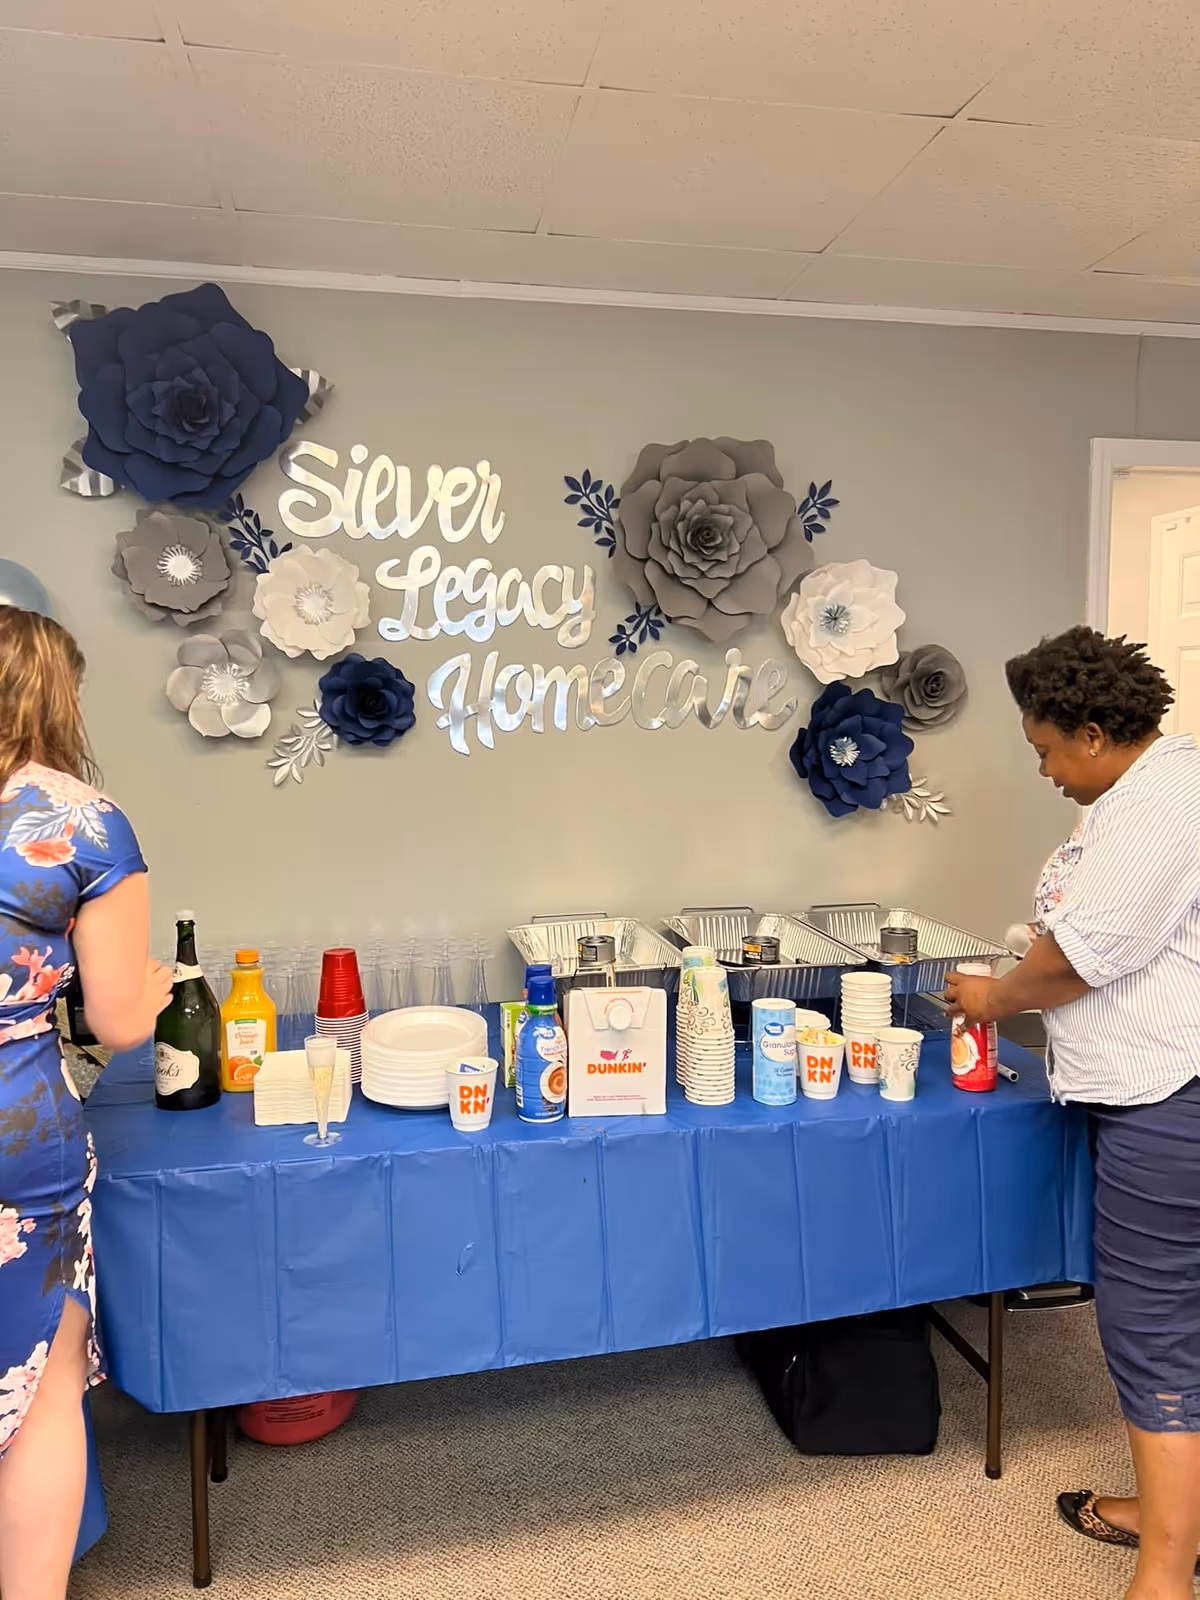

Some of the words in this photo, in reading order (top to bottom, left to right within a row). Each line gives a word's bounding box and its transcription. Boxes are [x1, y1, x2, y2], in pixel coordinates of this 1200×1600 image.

[278, 440, 506, 544] Silver
[375, 545, 596, 648] Legacy
[851, 1041, 876, 1056] DN
[587, 1062, 647, 1074] DUNKIN'
[806, 1055, 833, 1070] DN
[807, 1069, 836, 1083] KN'
[458, 1084, 488, 1099] DN
[459, 1097, 490, 1114] KN'
